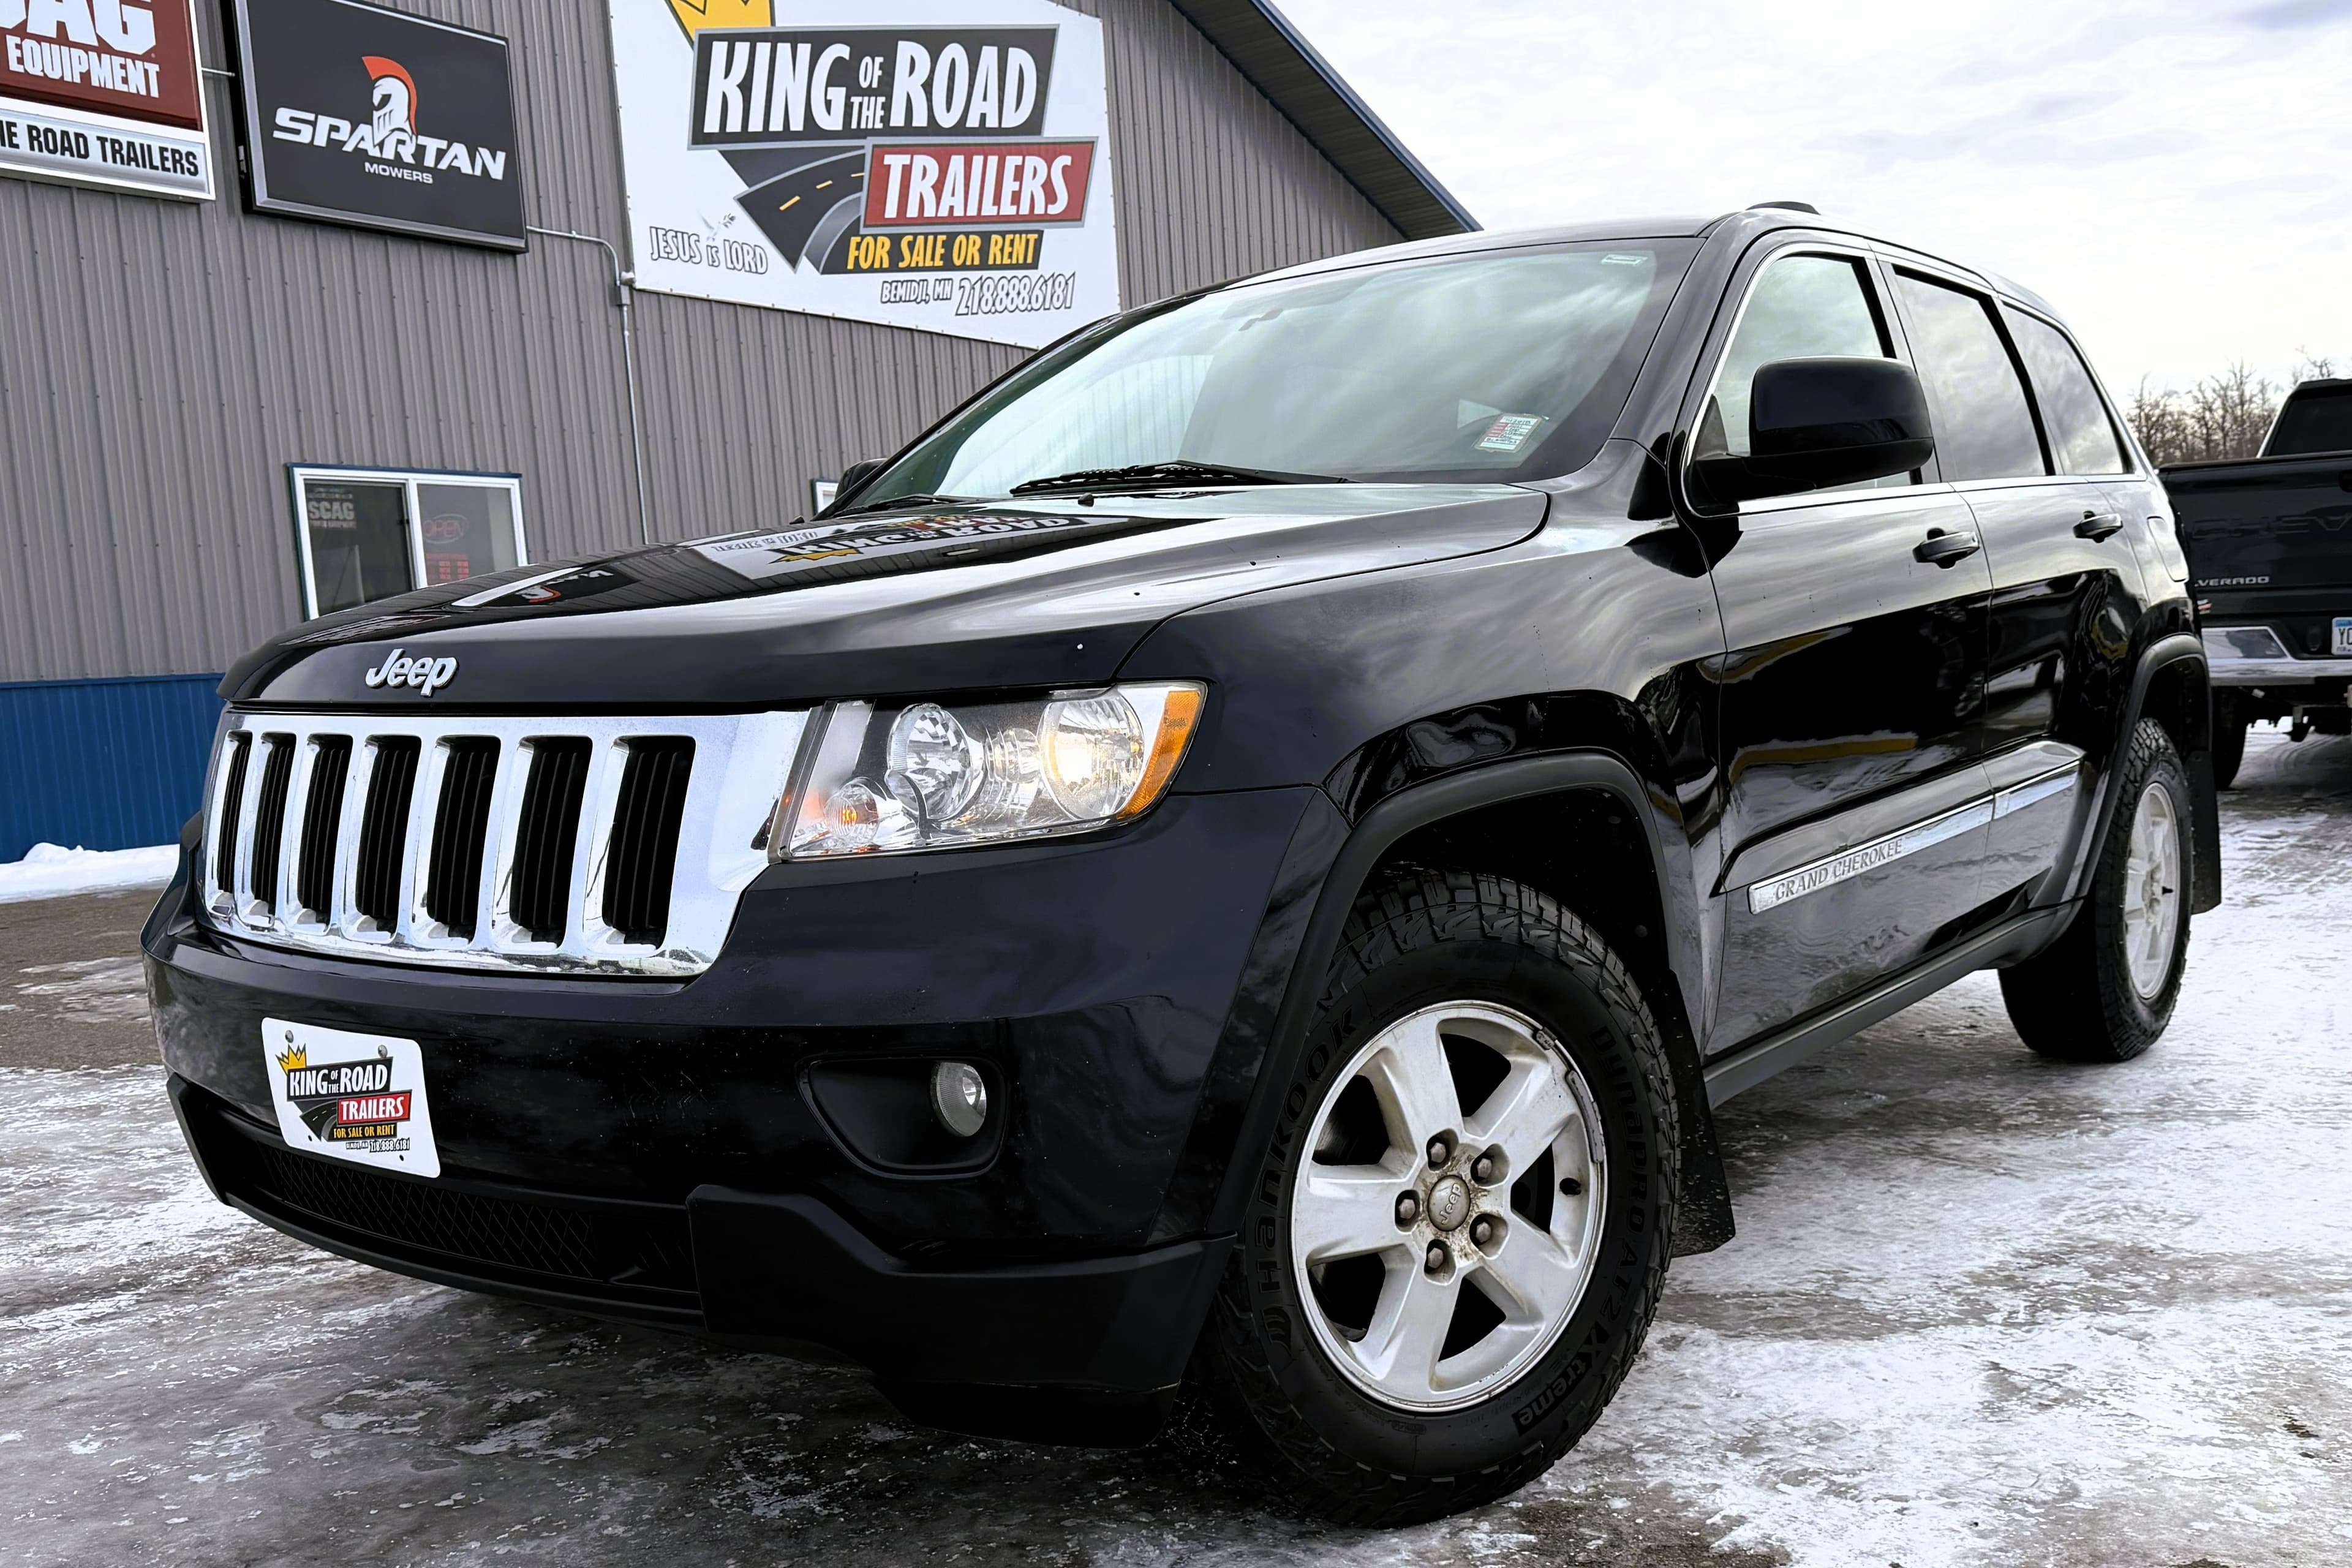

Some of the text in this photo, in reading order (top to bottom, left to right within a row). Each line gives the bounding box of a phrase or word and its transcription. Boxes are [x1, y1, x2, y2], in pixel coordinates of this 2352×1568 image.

[6, 34, 160, 98] EQUIPMENT
[704, 40, 1037, 133] KING OF THE ROAD
[27, 124, 89, 159] ROAD
[96, 136, 198, 176] TRAILERS
[273, 107, 506, 180] SPARTAN
[364, 162, 433, 184] MOWERS
[883, 154, 1072, 218] TRAILERS
[649, 226, 768, 274] JESUS IS LORD
[846, 234, 1038, 270] FOR SALE OR RENT
[880, 271, 1076, 316] BEMIDJI, MN 218.888.6181
[308, 501, 355, 520] SCAG
[2195, 576, 2269, 587] VERADO
[365, 648, 458, 697] Jeep
[1776, 839, 1902, 901] GRAND CHEROKEE
[290, 1065, 387, 1096] KING OF THE ROAD
[341, 1096, 404, 1120] TRAILERS
[334, 1125, 394, 1138] FOR SALE OR RENT
[1439, 1183, 1461, 1224] Jeep
